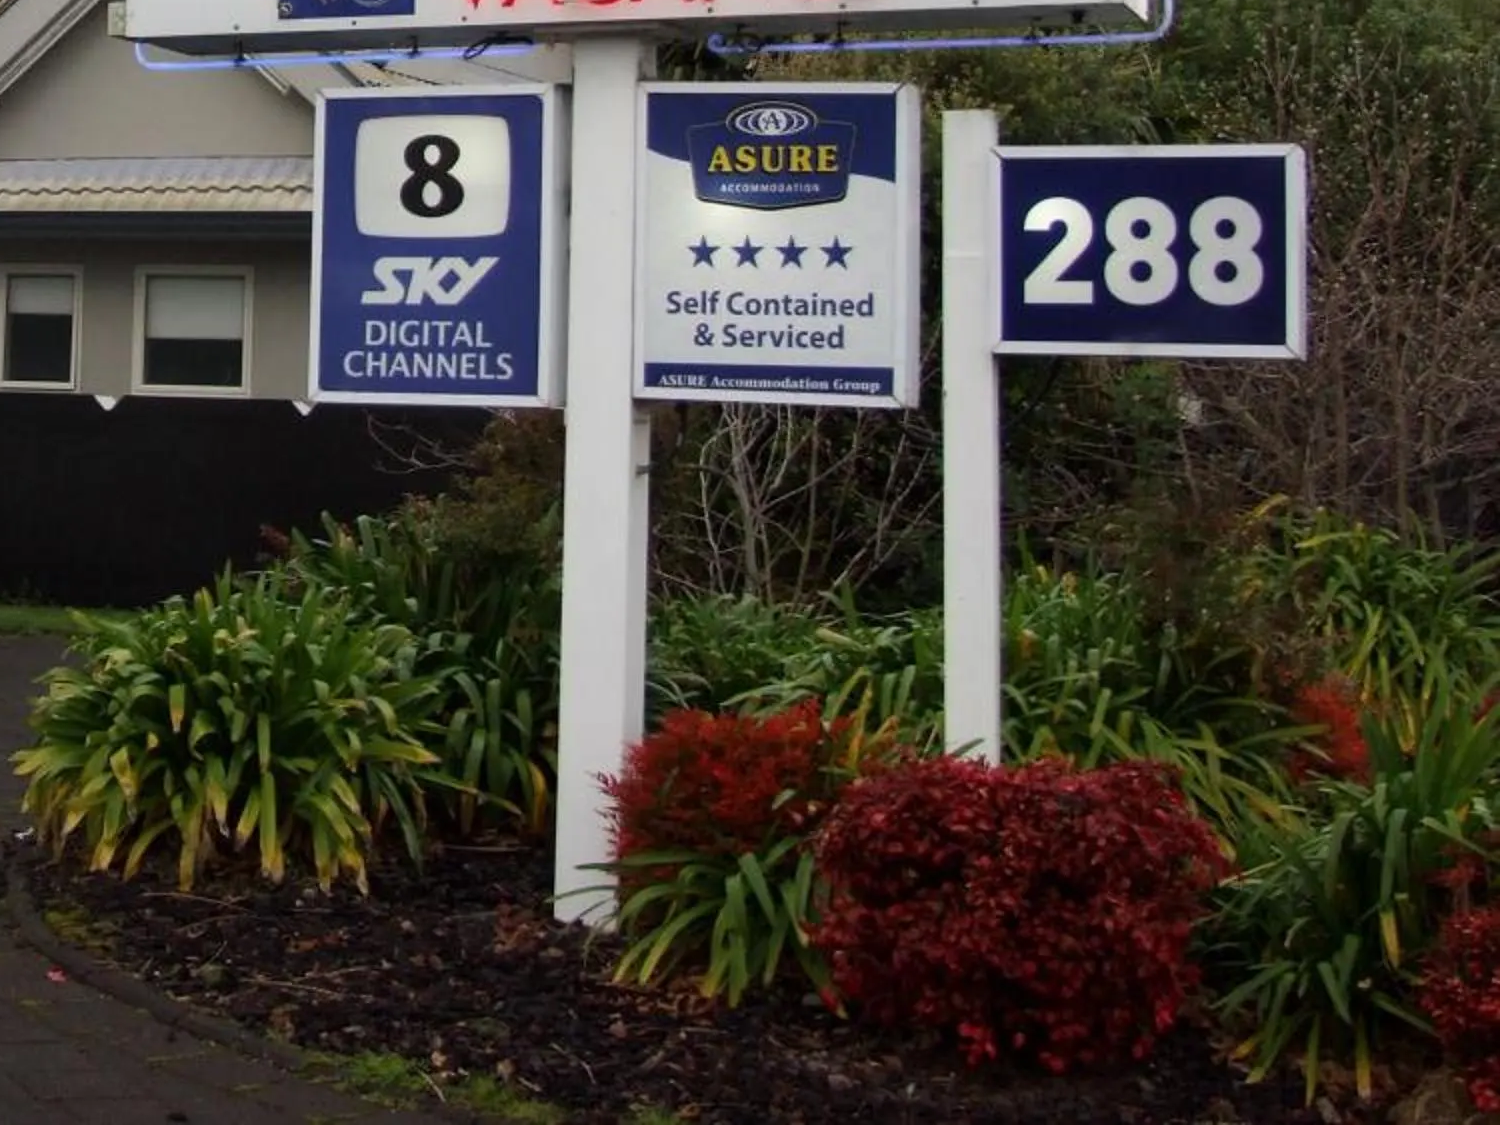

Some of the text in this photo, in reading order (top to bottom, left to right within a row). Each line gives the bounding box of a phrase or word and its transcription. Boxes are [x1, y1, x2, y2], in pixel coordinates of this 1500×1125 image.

[707, 144, 840, 173] ASURE
[400, 134, 465, 218] 8
[719, 182, 820, 193] ACCOMMODATION
[1023, 195, 1264, 306] 288
[360, 256, 500, 305] SKY
[666, 290, 874, 317] Self Contained
[364, 320, 492, 348] DIGITAL
[693, 323, 845, 349] & Serviced
[343, 350, 514, 380] CHANNELS
[658, 374, 882, 394] ASURE Accommodation Group
